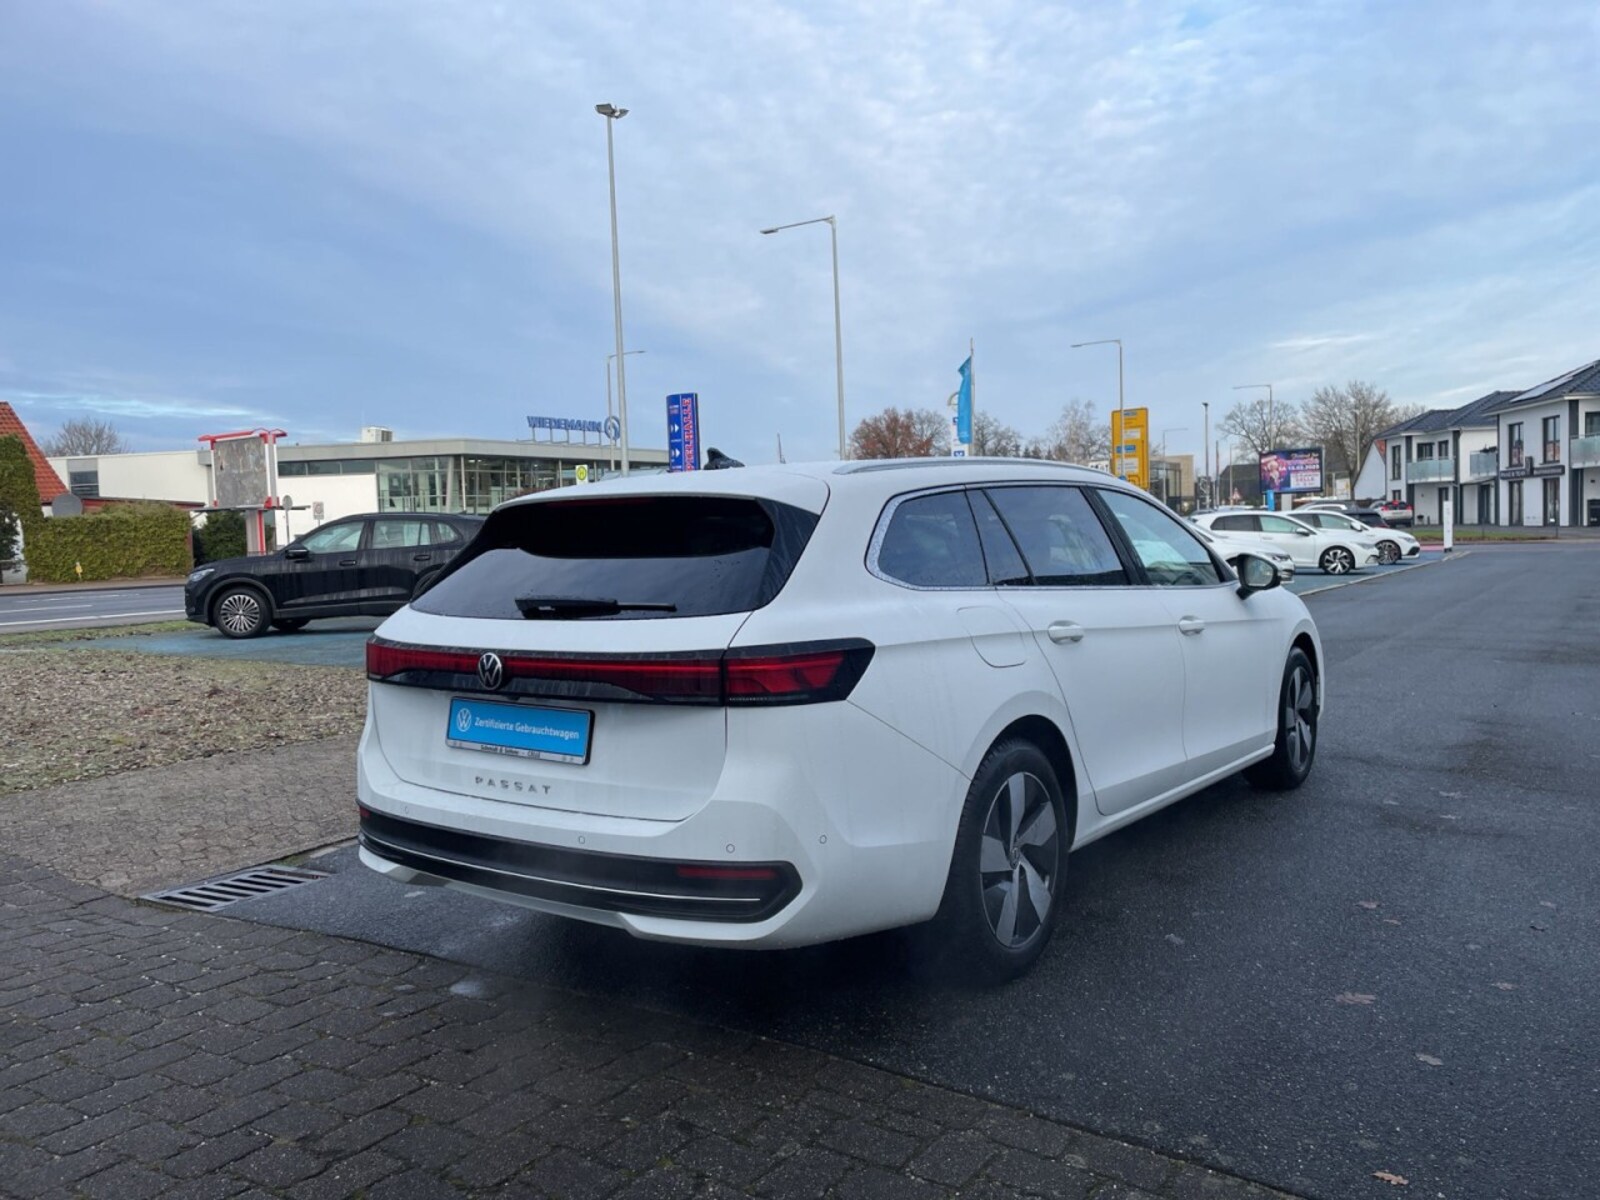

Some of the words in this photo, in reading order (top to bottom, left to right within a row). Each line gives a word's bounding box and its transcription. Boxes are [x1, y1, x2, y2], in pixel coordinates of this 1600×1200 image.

[527, 416, 602, 432] WIEDEMANN
[682, 398, 695, 471] PIELHALLE
[474, 717, 514, 731] Zertifizierte
[515, 722, 579, 740] Gebrauchtwagen
[475, 776, 552, 794] PASSAT
